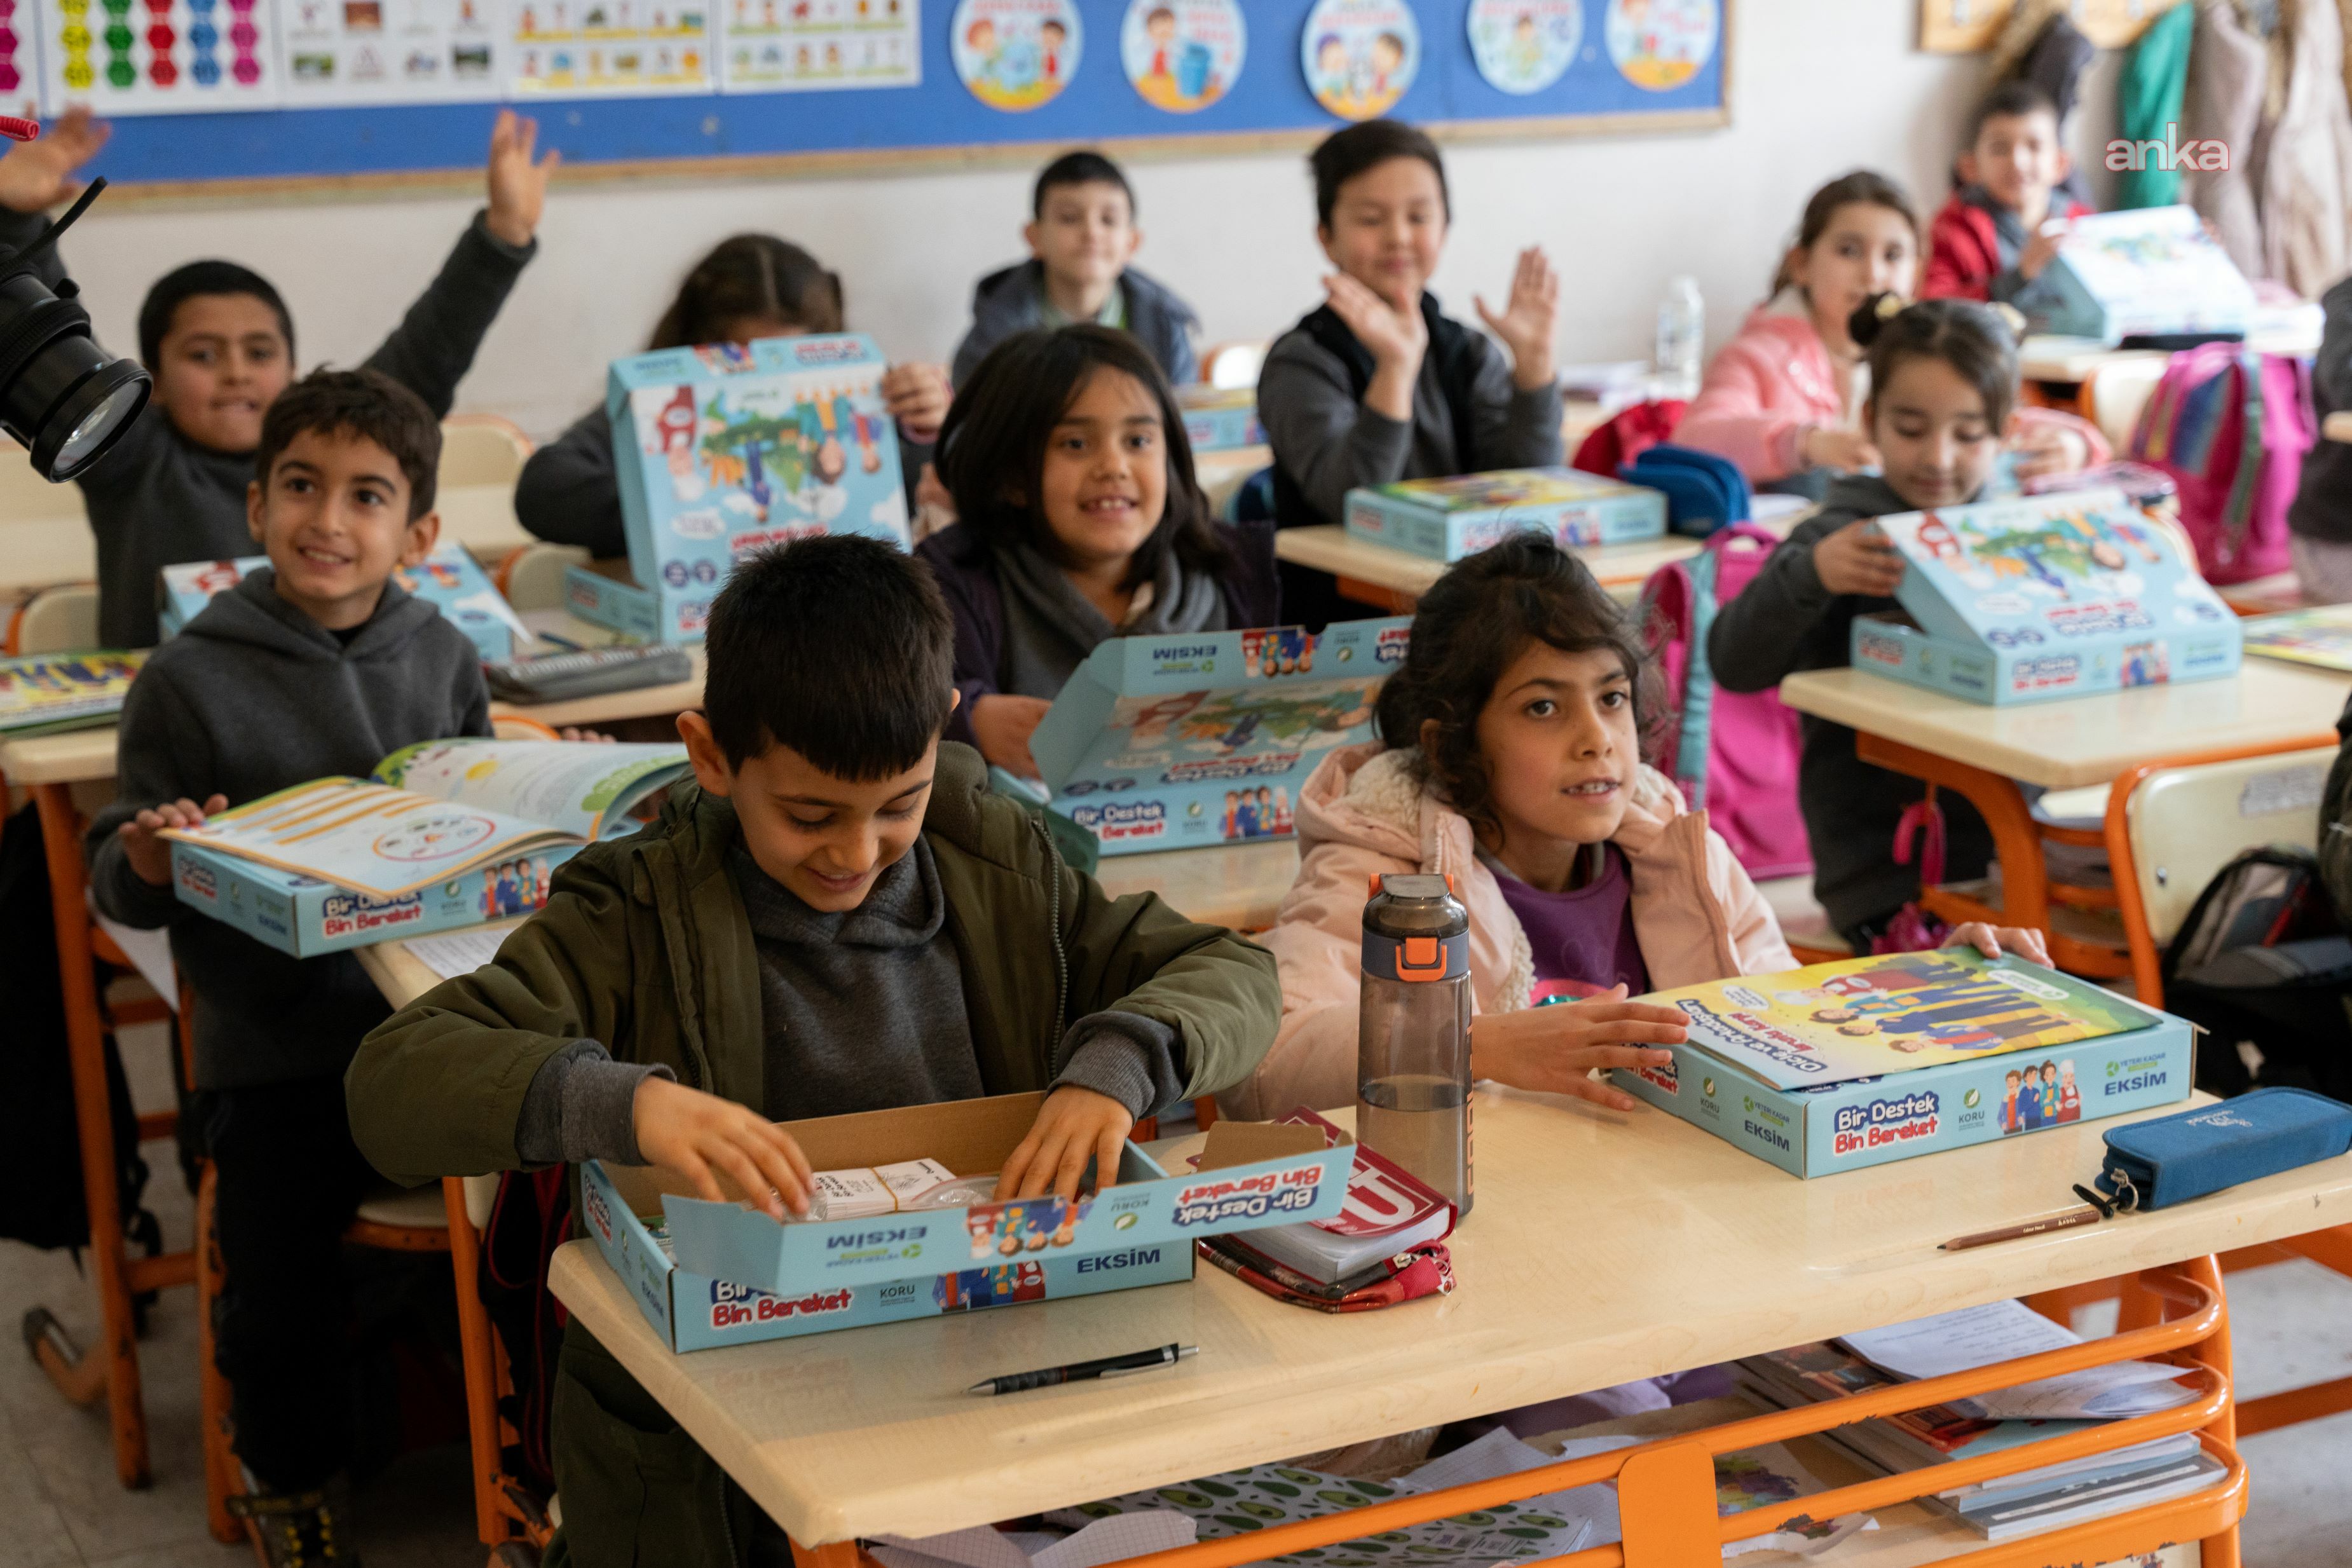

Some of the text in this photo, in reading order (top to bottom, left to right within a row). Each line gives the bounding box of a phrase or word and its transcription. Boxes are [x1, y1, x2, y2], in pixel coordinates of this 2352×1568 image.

[2104, 1072, 2166, 1096] EKSİM
[1700, 1098, 1720, 1114] KORU
[1838, 1094, 1936, 1130] Bir Destek
[1959, 1110, 1985, 1124] KORU
[1744, 1119, 1790, 1152] EKSİM
[1835, 1115, 1938, 1154] Bin Bereket
[1180, 1166, 1322, 1204] Bin Bereket
[1179, 1187, 1313, 1223] Bir Destek
[828, 1226, 927, 1249] EKSİM
[1077, 1248, 1161, 1274] EKSİM
[880, 1285, 915, 1299] KORU
[713, 1288, 852, 1327] Bin Bereket
